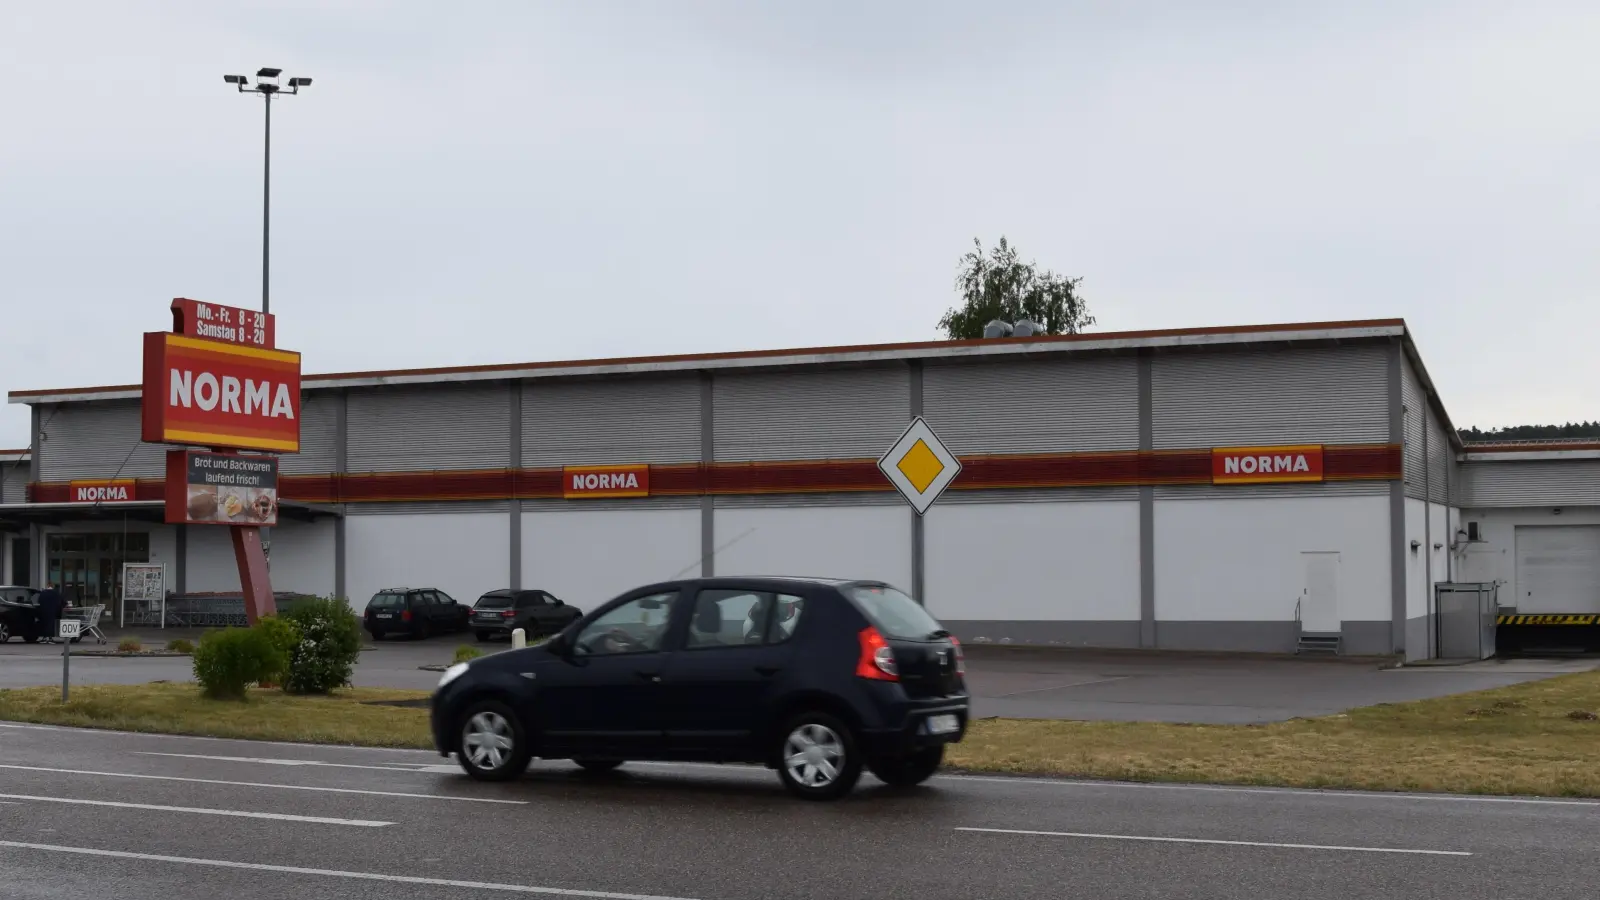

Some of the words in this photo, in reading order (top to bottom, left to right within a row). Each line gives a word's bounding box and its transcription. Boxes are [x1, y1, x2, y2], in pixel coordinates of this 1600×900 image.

[239, 310, 245, 326] 8
[253, 312, 265, 329] 20
[197, 320, 236, 342] Samstag
[239, 327, 245, 343] 8
[253, 328, 265, 345] 20
[170, 368, 294, 420] NORMA
[194, 457, 212, 468] Brot
[213, 459, 229, 469] und
[229, 460, 271, 473] Backwaren
[1224, 455, 1309, 474] NORMA
[205, 472, 235, 484] laufend
[236, 475, 260, 486] frisch!
[573, 473, 639, 490] NORMA
[78, 486, 128, 501] NORMA
